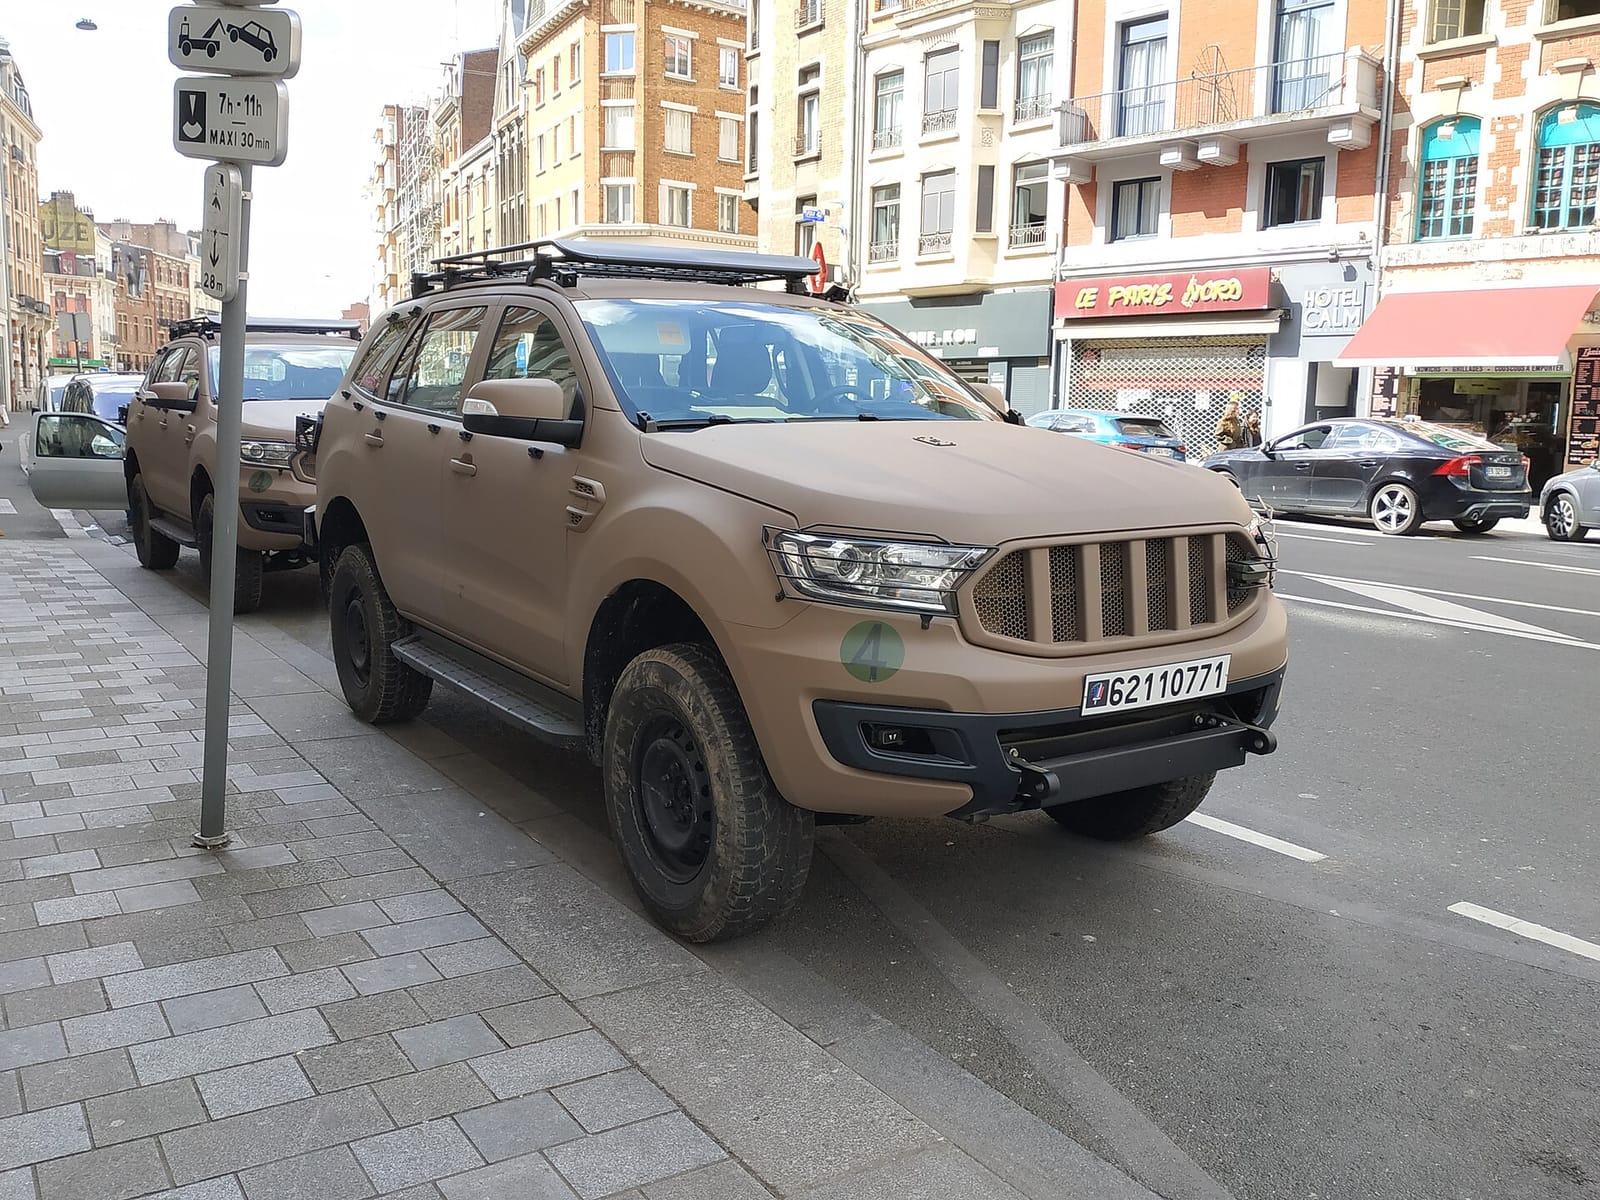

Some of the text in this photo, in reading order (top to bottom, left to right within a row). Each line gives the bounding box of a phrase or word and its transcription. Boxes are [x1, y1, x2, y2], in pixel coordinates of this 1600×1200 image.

[210, 129, 237, 146] MAXI
[1075, 287, 1099, 309] LE
[1108, 283, 1173, 307] PARIS
[1304, 287, 1362, 308] HÔTEL
[1304, 308, 1361, 329] CALM
[1531, 364, 1564, 372] EMPORTER
[851, 623, 888, 680] 4
[1109, 661, 1224, 706] 62110771
